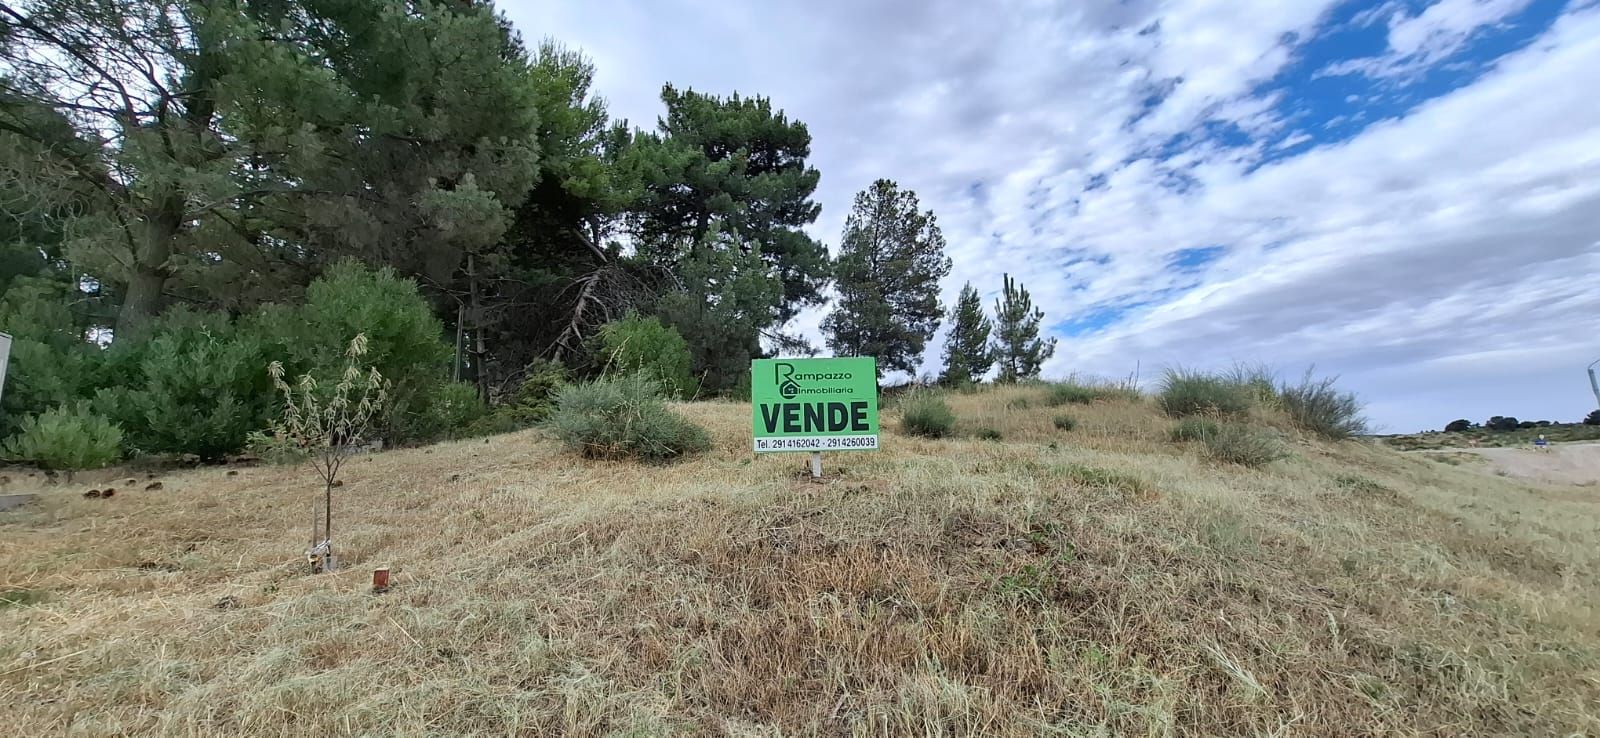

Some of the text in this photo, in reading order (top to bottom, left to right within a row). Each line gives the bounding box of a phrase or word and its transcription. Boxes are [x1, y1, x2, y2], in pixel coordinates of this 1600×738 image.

[775, 363, 852, 387] Rampazzo
[760, 401, 870, 433] VENDE
[757, 439, 770, 448] Tel.
[772, 439, 820, 448] 2914162042
[827, 437, 875, 447] 2914260039
